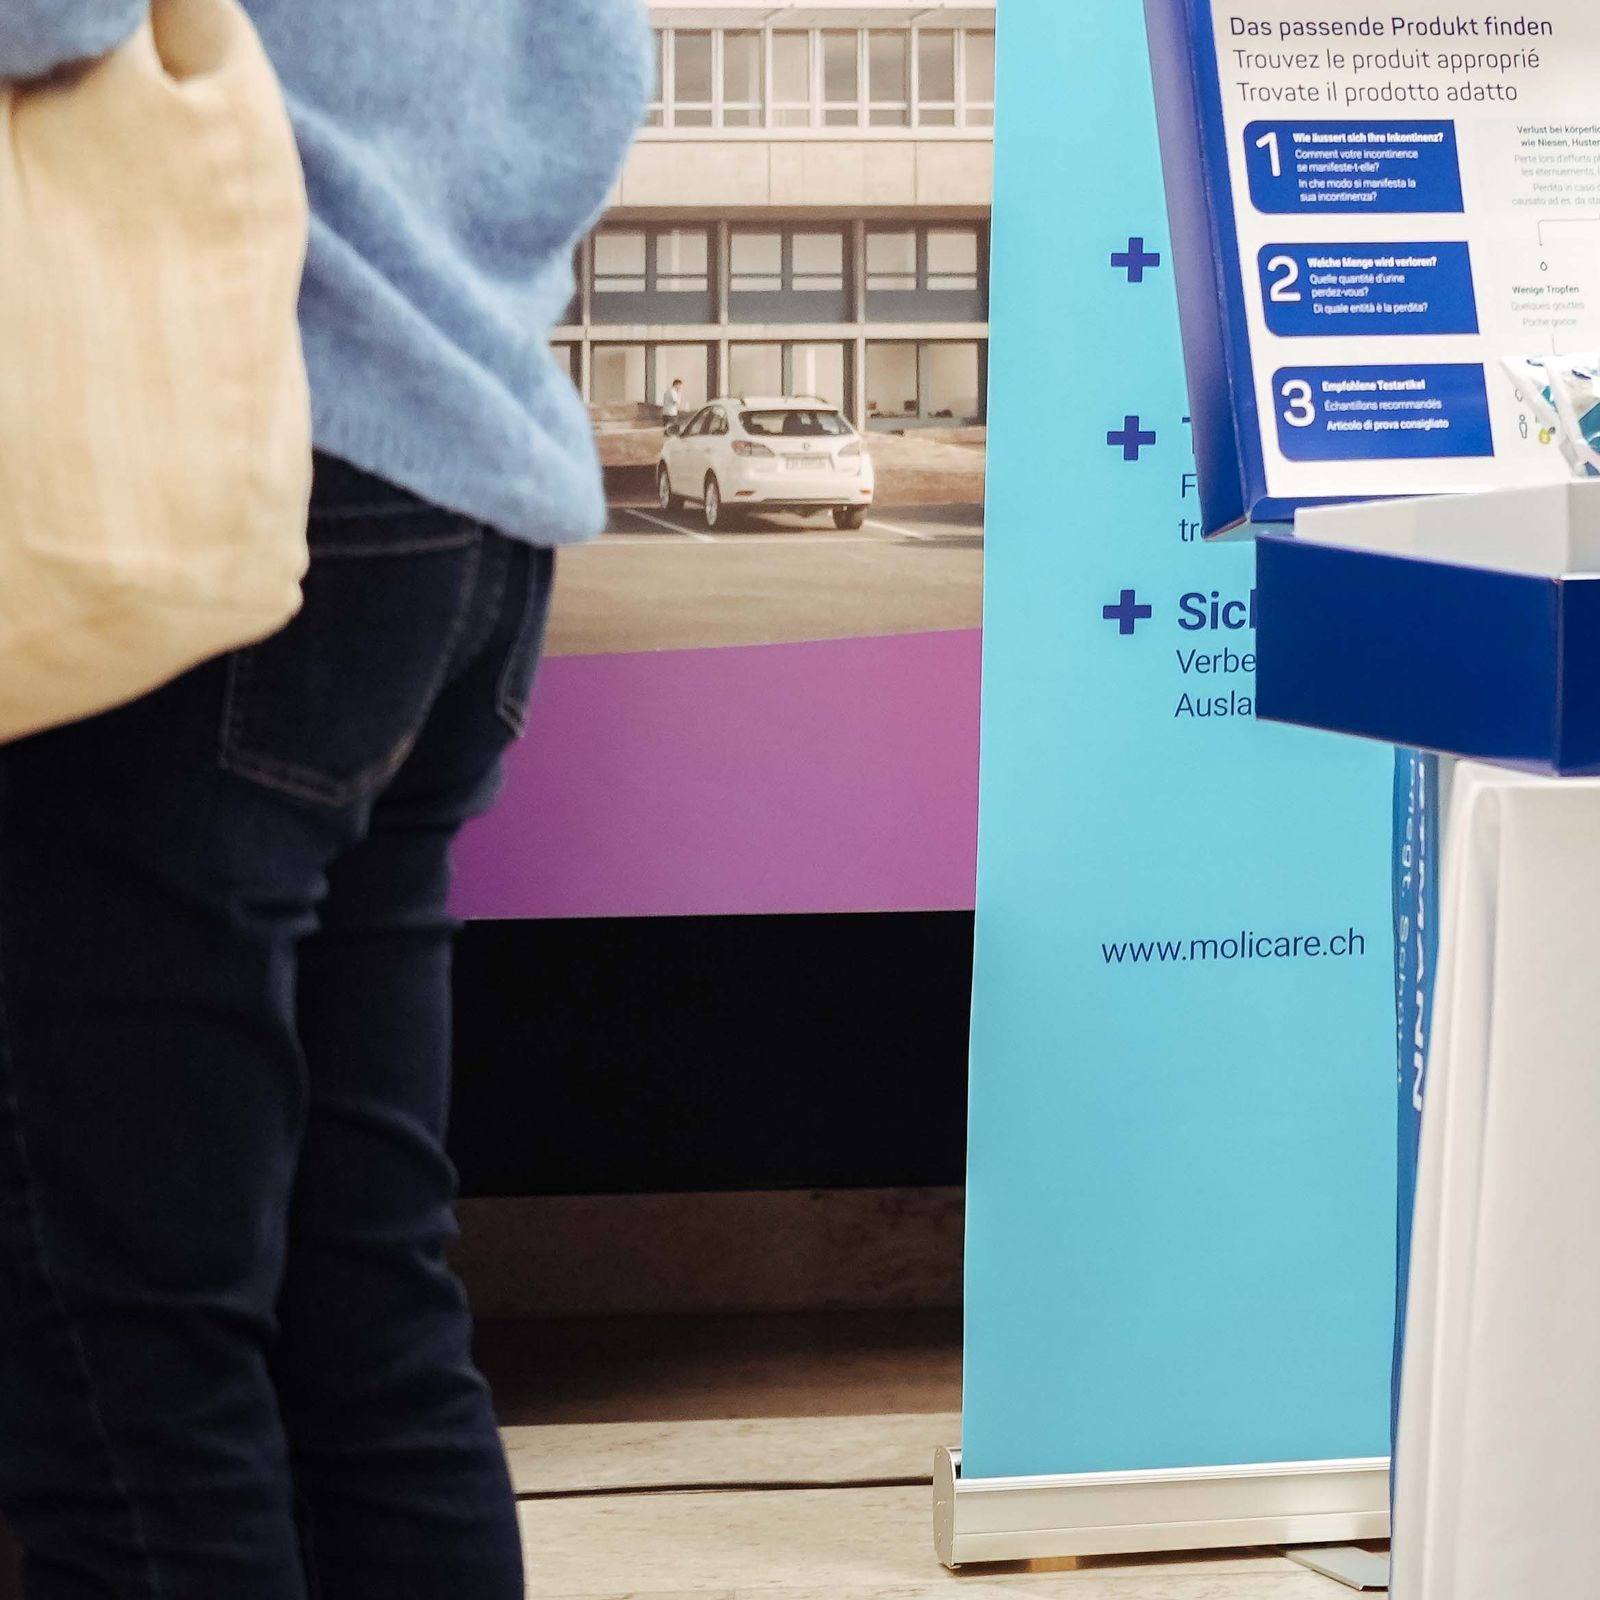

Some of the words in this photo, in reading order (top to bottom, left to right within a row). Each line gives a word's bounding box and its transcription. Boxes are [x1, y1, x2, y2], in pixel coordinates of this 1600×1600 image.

[1230, 16, 1272, 36] Das
[1279, 16, 1385, 41] passende
[1391, 16, 1479, 36] Produkt
[1484, 16, 1554, 36] finden
[1233, 49, 1320, 69] Trouvez
[1326, 48, 1345, 69] le
[1353, 49, 1431, 73] produit
[1437, 48, 1541, 74] approprié
[1236, 82, 1320, 102] Trovate
[1326, 81, 1338, 102] il
[1345, 82, 1440, 106] prodotto
[1447, 81, 1518, 102] adatto
[1516, 125, 1547, 134] Verlust
[1549, 125, 1563, 134] bei
[1255, 131, 1281, 177] 1
[1363, 149, 1419, 159] incontinence
[1266, 255, 1301, 302] 2
[1512, 286, 1544, 296] Wenige
[1546, 285, 1580, 296] Tropfen
[1280, 379, 1316, 427] 3
[1100, 928, 1367, 966] www.molicare.ch
